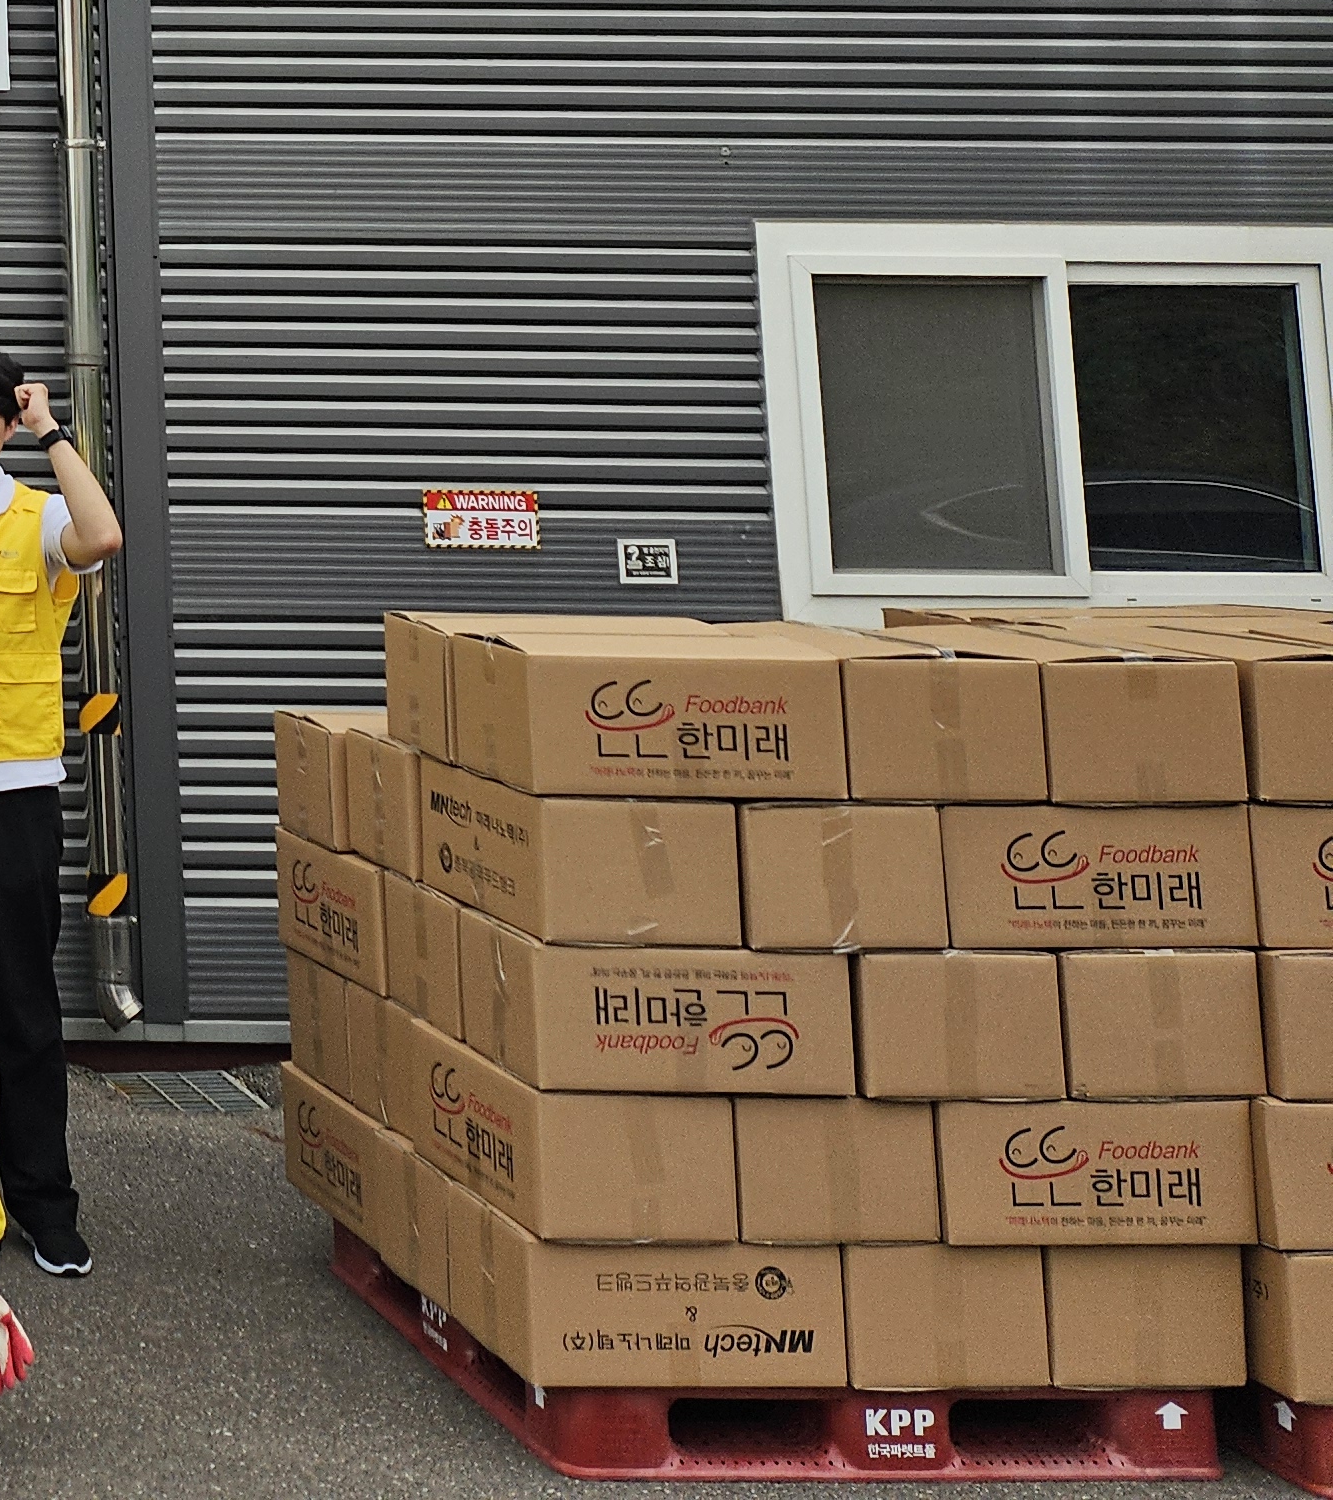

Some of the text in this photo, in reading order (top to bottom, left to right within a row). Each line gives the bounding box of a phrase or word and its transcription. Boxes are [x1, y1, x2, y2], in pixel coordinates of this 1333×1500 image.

[454, 494, 527, 511] WARNING
[468, 516, 534, 541] 충돌주의
[684, 695, 789, 716] Foodbank
[1099, 844, 1200, 864] Foodbank
[596, 1034, 700, 1055] Foodbank
[1098, 1141, 1200, 1161] Foodbank
[596, 1273, 750, 1294] 충북광역푸드뱅크
[562, 1329, 814, 1358] MNtech 미래나노텍(주)
[865, 1408, 935, 1436] KPP
